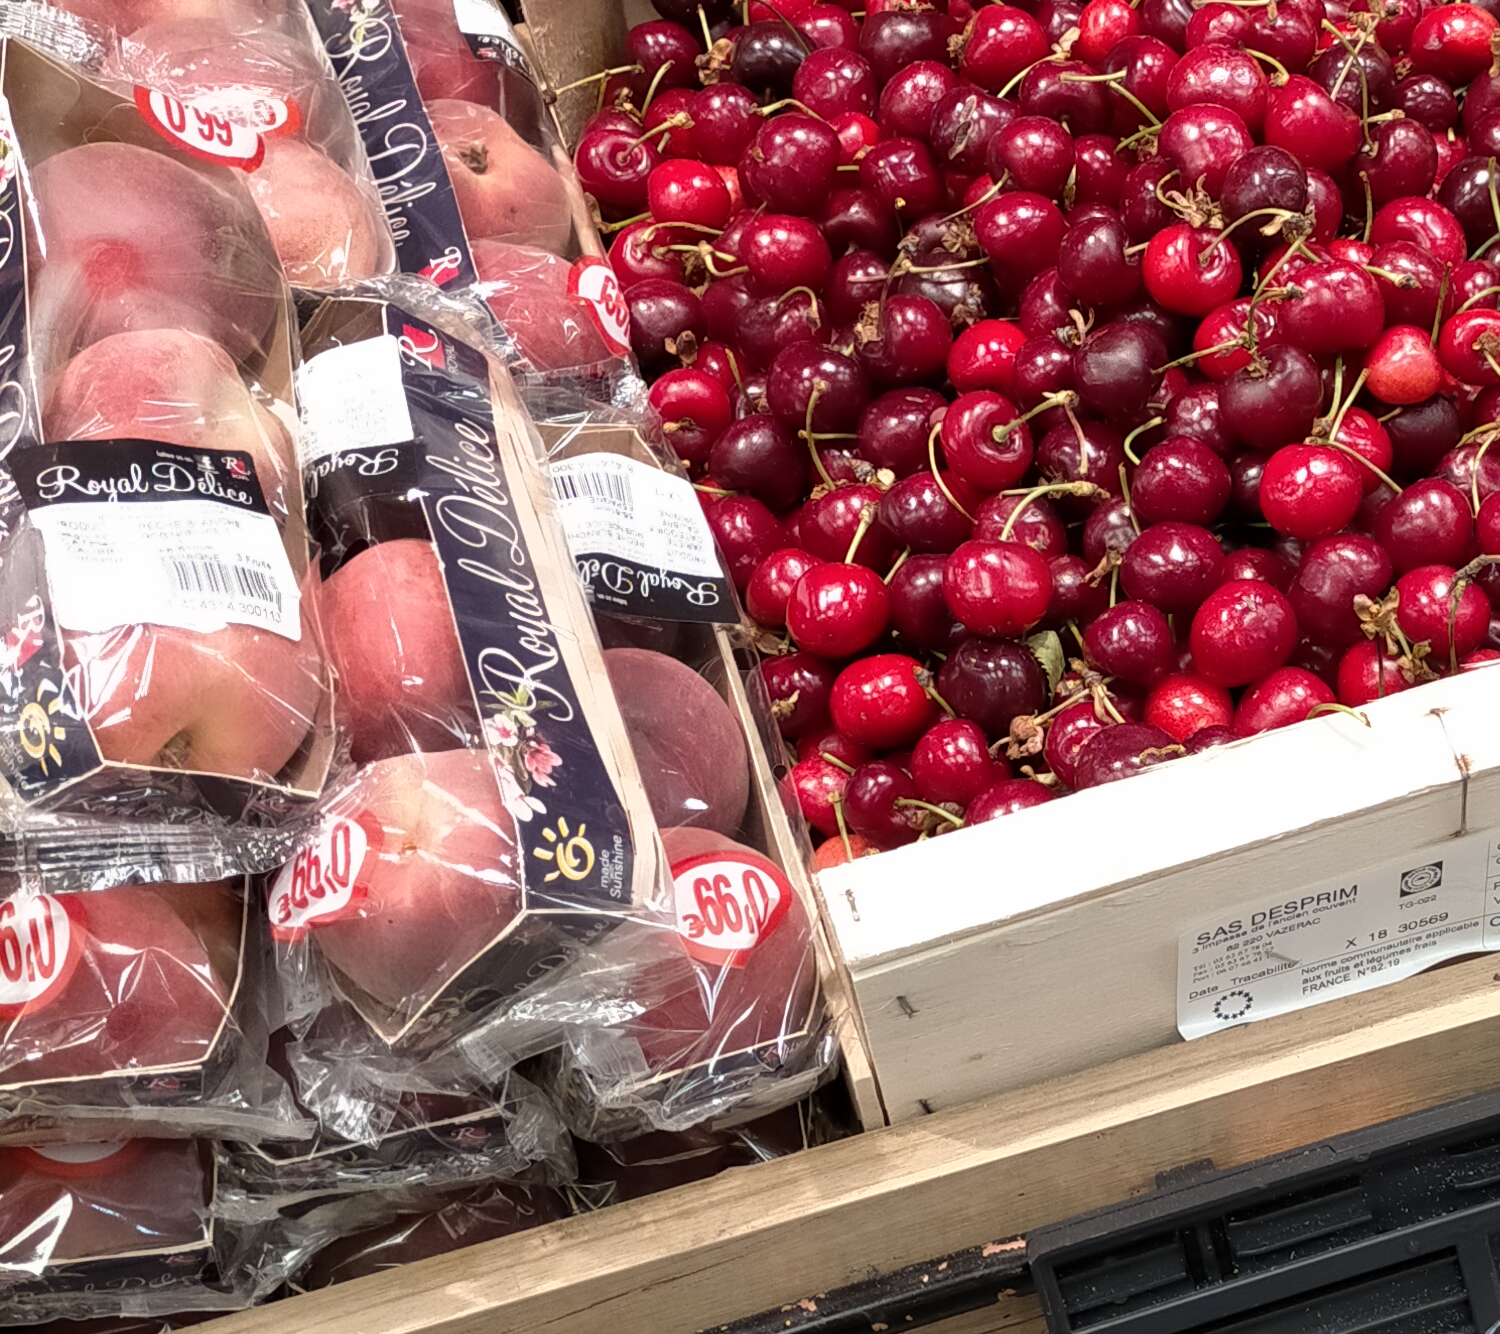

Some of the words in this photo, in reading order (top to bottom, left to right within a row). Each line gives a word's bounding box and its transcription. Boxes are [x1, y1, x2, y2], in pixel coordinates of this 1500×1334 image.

[36, 463, 148, 504] Royal
[152, 461, 252, 505] Délice
[426, 418, 525, 565] Délice
[637, 568, 720, 606] Royal
[457, 557, 579, 721] Royal
[610, 834, 623, 899] Sunshine
[1197, 919, 1243, 945] SAS
[1251, 884, 1358, 925] DESPRIM
[1398, 894, 1437, 910] TG-022
[1242, 934, 1263, 948] 220
[1265, 917, 1321, 939] VAZERAC
[1301, 960, 1338, 976] Norme
[1340, 934, 1424, 965] communautaire
[1426, 920, 1480, 940] applicable
[1345, 938, 1357, 949] X
[1369, 928, 1388, 942] 18
[1398, 912, 1449, 934] 30569
[1302, 974, 1323, 986] aux
[1325, 964, 1350, 980] fruits
[1353, 962, 1364, 972] et
[1367, 948, 1412, 971] légumes
[1414, 938, 1438, 953] frais
[1189, 984, 1219, 1000] Date
[1302, 974, 1351, 996] FRANCE
